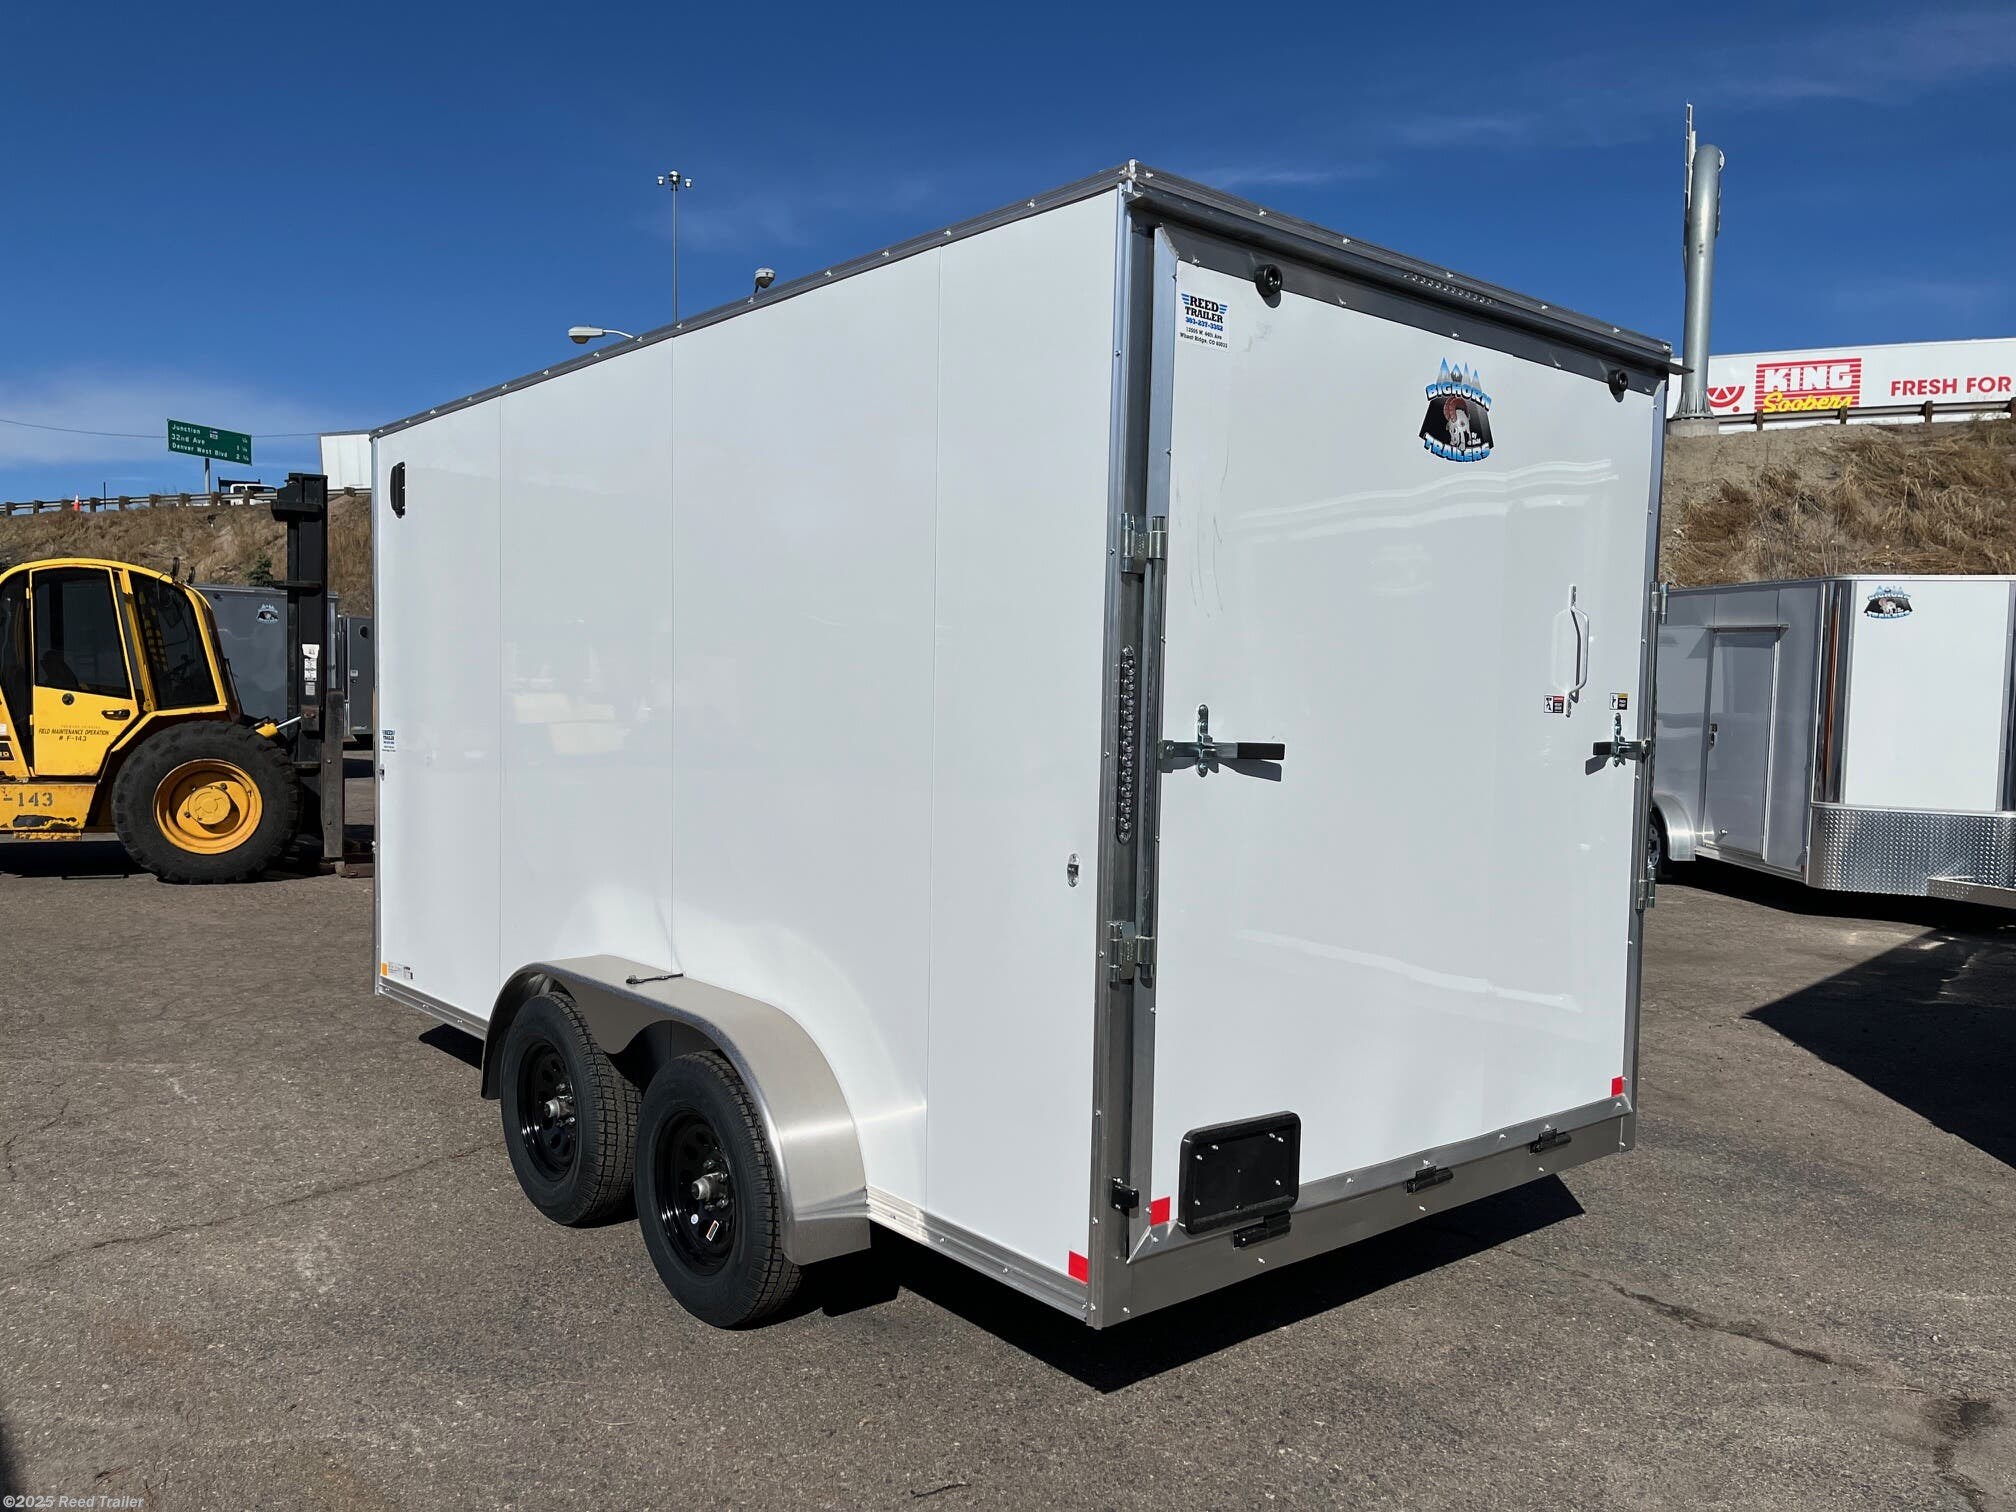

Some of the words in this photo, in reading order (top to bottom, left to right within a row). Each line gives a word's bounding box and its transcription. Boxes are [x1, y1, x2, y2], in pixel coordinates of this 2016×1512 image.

[1190, 296, 1219, 312] REED
[1185, 306, 1223, 323] TRAILER
[1180, 332, 1194, 340] Wheat
[1764, 365, 1852, 393] KING
[1891, 378, 1957, 396] FRESH
[1966, 376, 2011, 393] FOR
[1426, 381, 1492, 412] BIGHORN
[172, 424, 201, 435] Junction
[171, 434, 190, 443] 32nd
[193, 437, 206, 445] Ave
[1424, 432, 1491, 462] TRAILERS
[172, 443, 194, 452] Denver
[197, 447, 212, 455] West
[214, 450, 228, 458] Blvd
